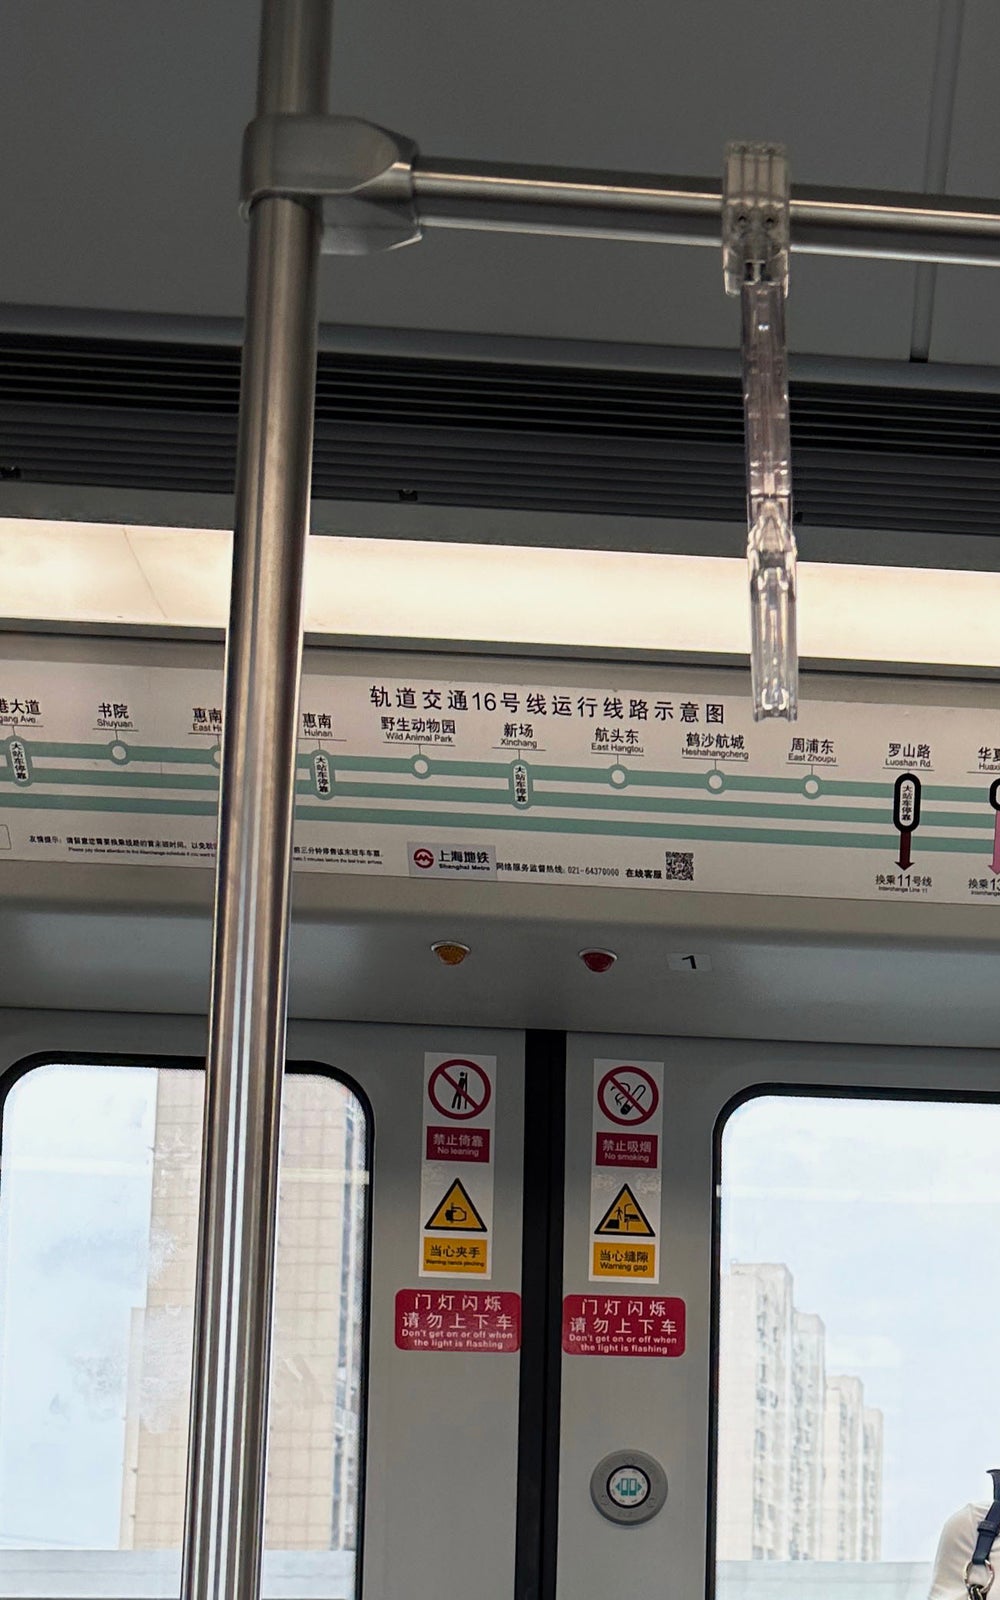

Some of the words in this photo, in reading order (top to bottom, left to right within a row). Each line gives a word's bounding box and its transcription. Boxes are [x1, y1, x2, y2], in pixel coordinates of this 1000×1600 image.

[98, 702, 130, 719] 书院
[370, 685, 724, 724] 轨道交通16号线运行线路示意图
[97, 719, 134, 729] Shuyuan
[192, 723, 211, 732] East
[302, 712, 332, 729] 惠南
[380, 716, 456, 734] 野生动物园
[304, 728, 333, 737] Huinan
[385, 732, 404, 741] Wild
[404, 733, 435, 742] Animal
[435, 734, 453, 743] Park
[503, 722, 534, 739] 新场
[594, 727, 639, 744] 航头东
[500, 738, 538, 749] Xinchang
[591, 742, 608, 751] East
[686, 732, 745, 750] 鹤沙航城
[790, 737, 834, 755] 周浦东
[682, 748, 750, 760] Heshahangcheng
[888, 743, 931, 759] 罗山路
[788, 753, 805, 761] East
[807, 754, 837, 764] Zhoupu
[885, 758, 918, 767] Luoshan
[919, 760, 933, 768] Rd.
[438, 850, 490, 864] 上海地铁
[439, 864, 470, 872] Shanghai
[625, 868, 662, 880] 在线客服
[875, 873, 932, 888] 换乘11号线
[432, 1133, 484, 1149] 禁止倚靠
[602, 1139, 652, 1154] 禁止吸烟
[437, 1146, 449, 1155] No
[450, 1147, 479, 1158] leaning
[604, 1153, 616, 1161] No
[617, 1153, 649, 1163] smoking
[430, 1244, 481, 1259] 当心夹手
[600, 1249, 649, 1263] 当心缝隙
[600, 1262, 632, 1271] Warning
[633, 1263, 649, 1272] gap
[414, 1293, 502, 1311] 门灯闪烁
[581, 1298, 666, 1317] 门灯闪烁
[402, 1311, 513, 1330] 请勿上下车
[569, 1316, 677, 1335] 请勿上下车
[401, 1329, 426, 1337] Don't
[429, 1330, 444, 1338] get
[488, 1331, 513, 1339] when
[569, 1333, 593, 1342] Don't
[595, 1335, 610, 1344] get
[638, 1335, 651, 1343] off
[653, 1336, 677, 1344] when
[414, 1339, 429, 1347] the
[431, 1340, 453, 1349] light
[466, 1340, 503, 1350] flashing
[597, 1344, 619, 1353] light
[621, 1344, 629, 1352] is
[631, 1345, 668, 1355] flashing
